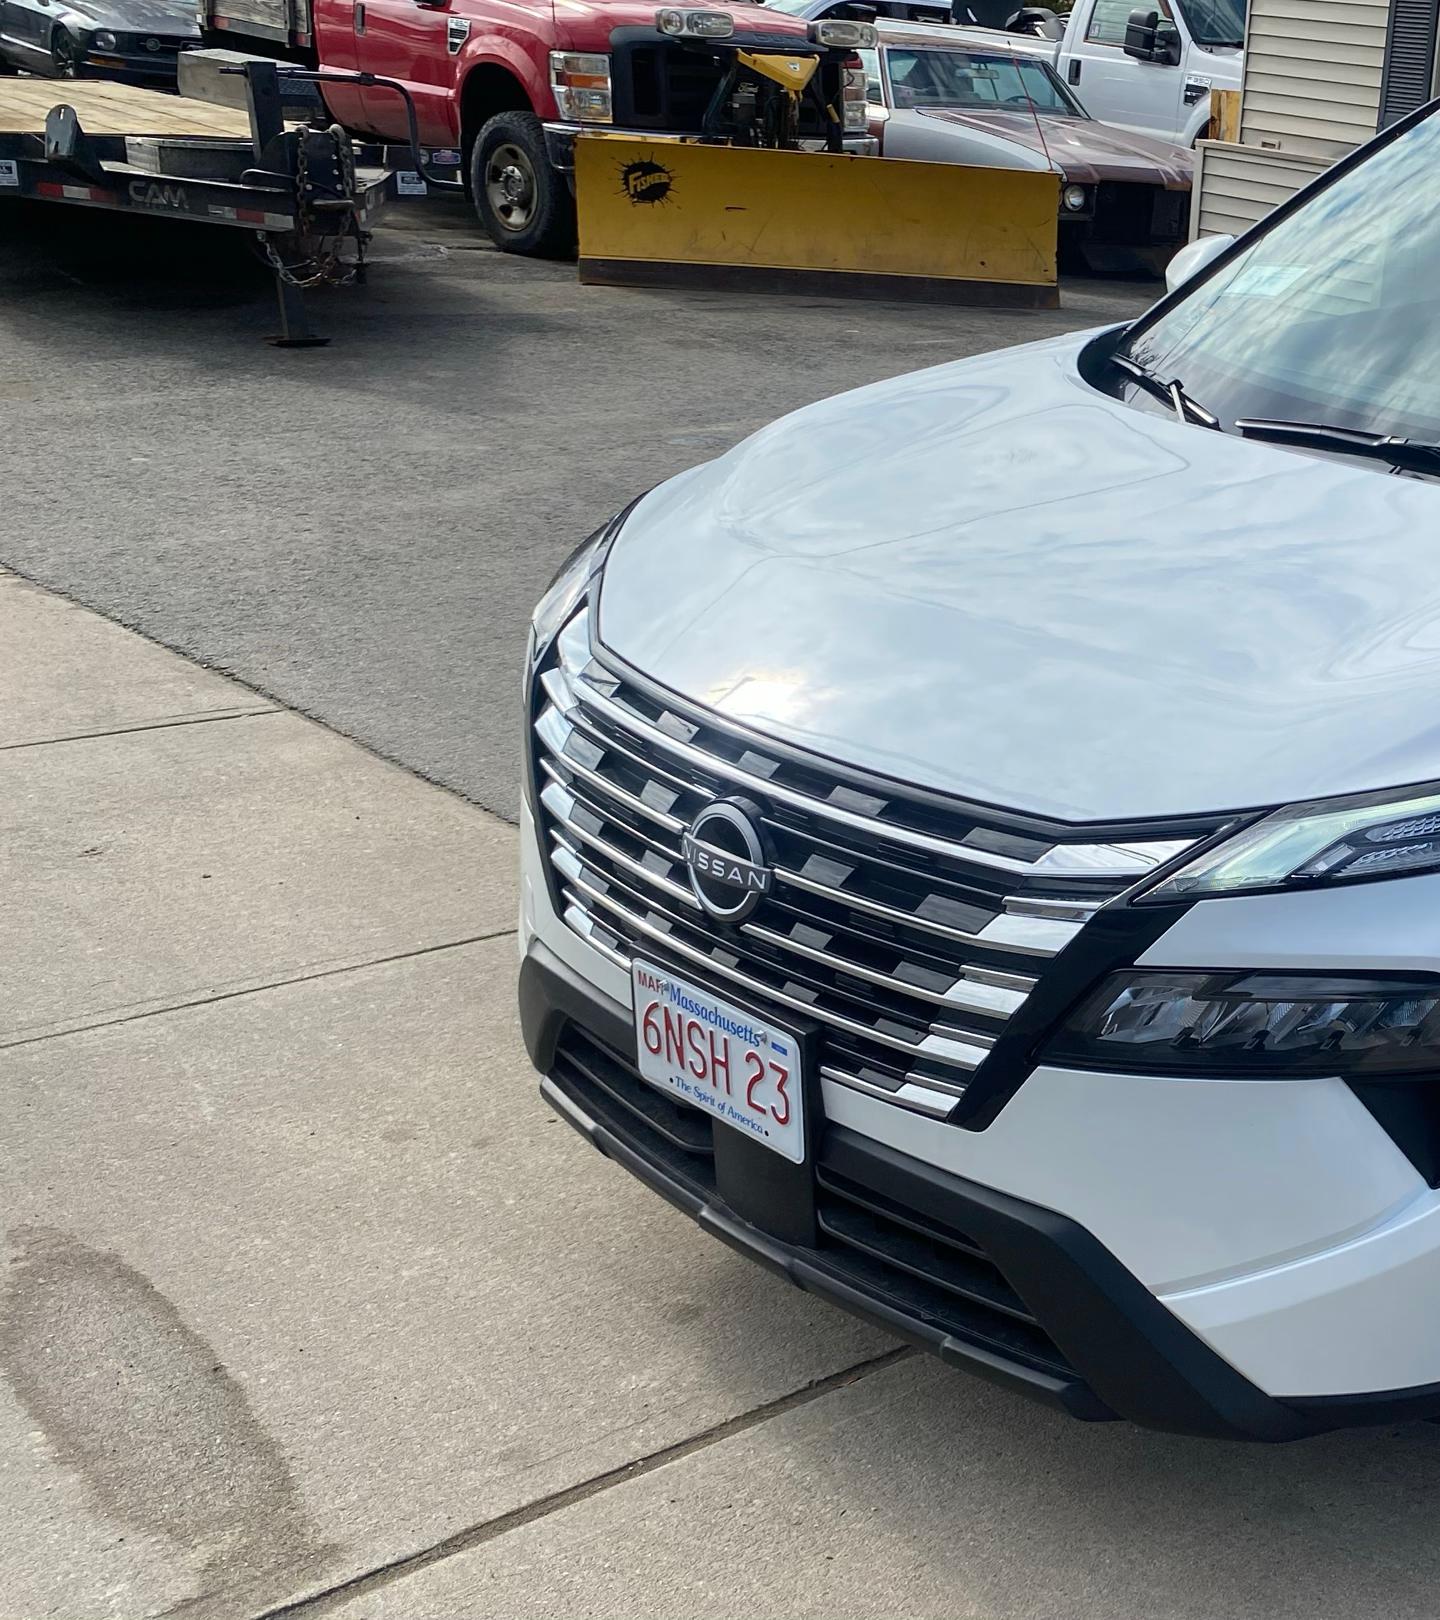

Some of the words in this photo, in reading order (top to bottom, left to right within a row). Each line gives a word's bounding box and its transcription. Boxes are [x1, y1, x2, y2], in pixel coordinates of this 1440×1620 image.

[128, 181, 189, 209] CAM
[683, 839, 766, 889] NISSAN
[670, 982, 762, 1047] Massachusetts
[643, 1001, 731, 1095] 6NSH
[745, 1050, 790, 1126] 23
[675, 1076, 692, 1094] The
[693, 1086, 715, 1107] Spirit
[717, 1102, 726, 1114] of
[727, 1106, 763, 1134] America
